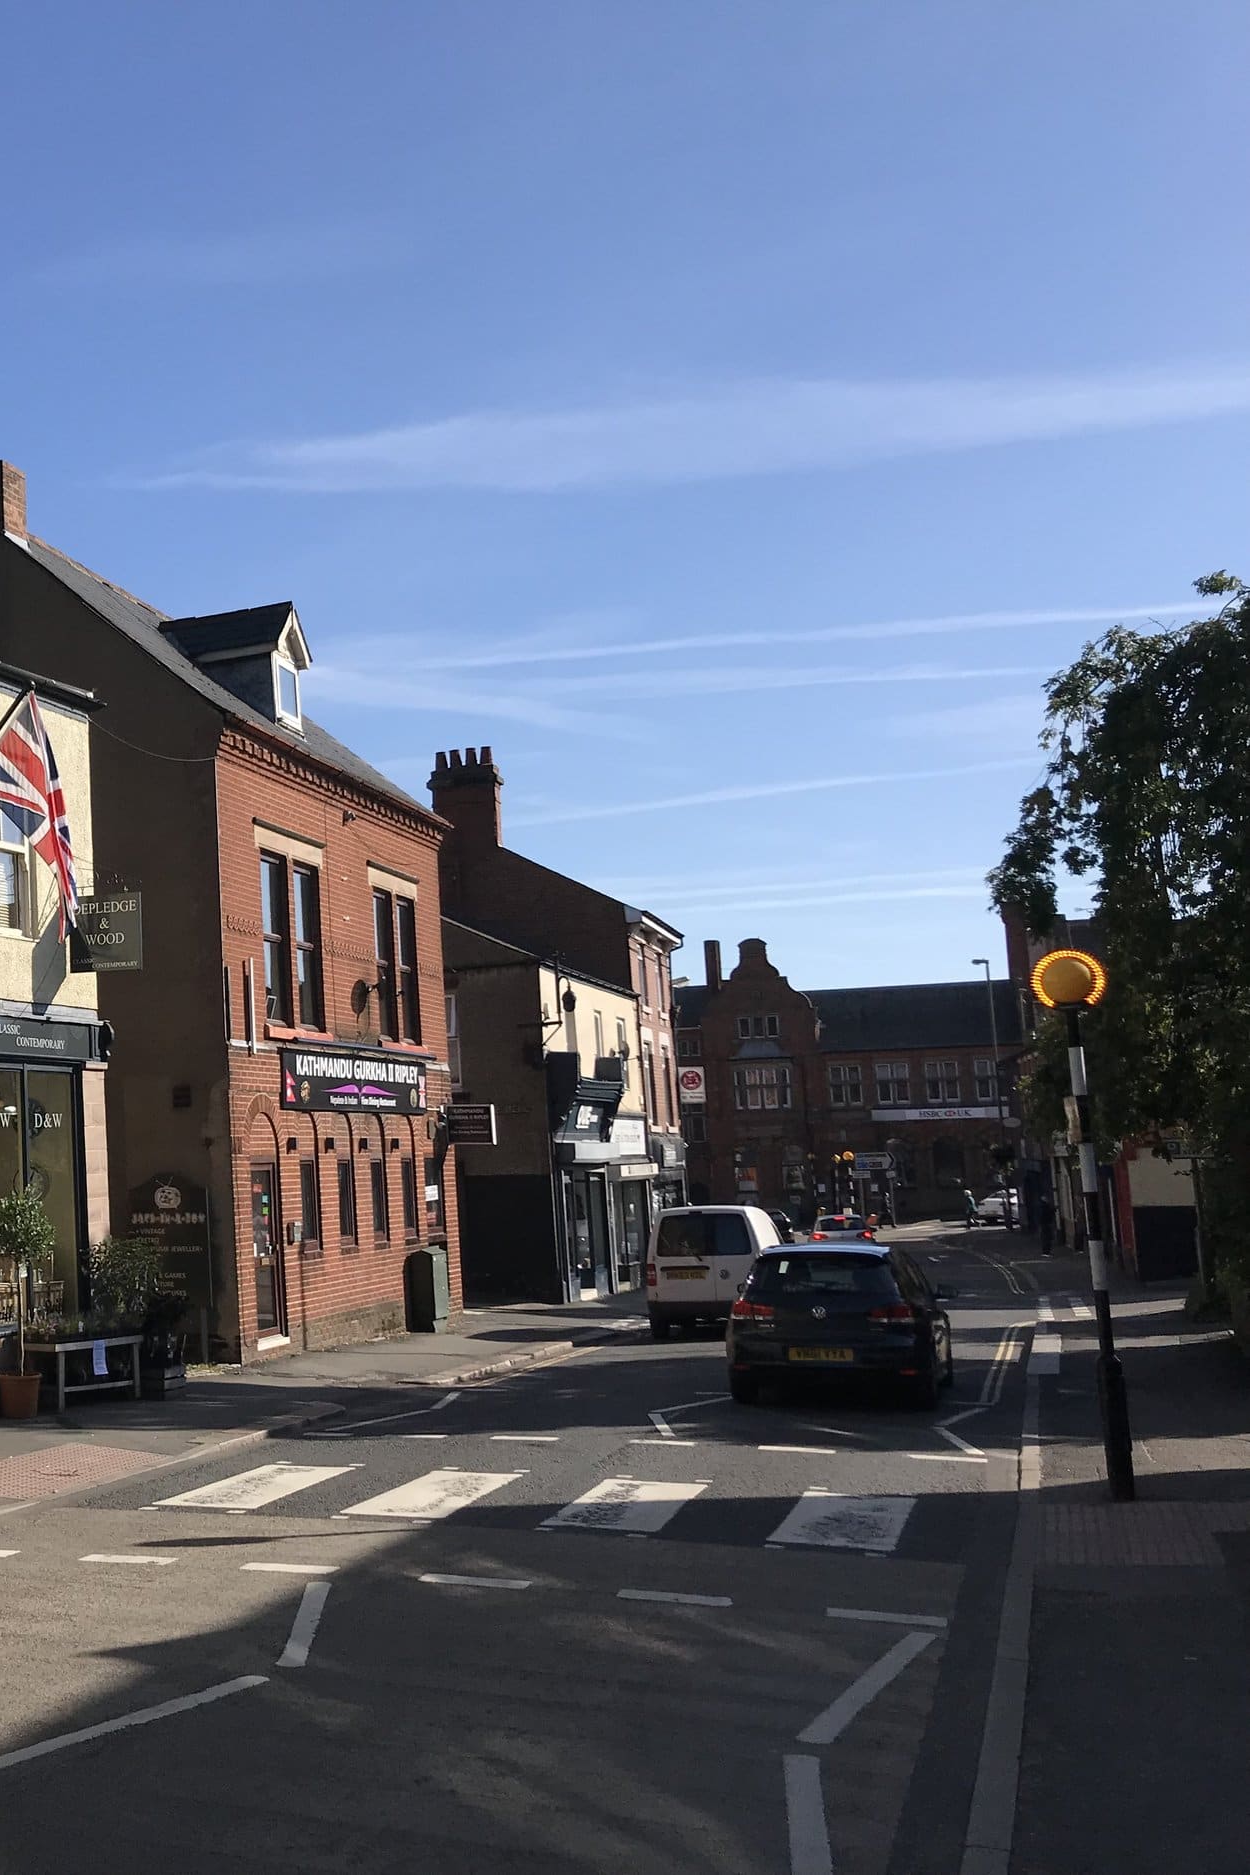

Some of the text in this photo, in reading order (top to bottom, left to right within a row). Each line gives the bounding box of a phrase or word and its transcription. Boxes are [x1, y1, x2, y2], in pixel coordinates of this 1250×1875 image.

[99, 917, 110, 930] &
[86, 932, 125, 946] WOOD
[92, 960, 138, 969] CONTEMPORARY
[16, 1036, 65, 1050] CONTEMPORARY
[296, 1054, 352, 1080] KATHMANDU
[354, 1060, 387, 1082] GURKHA
[395, 1064, 418, 1085] RIPLEY
[34, 1113, 62, 1128] D&W
[919, 1109, 972, 1118] HSBC UK
